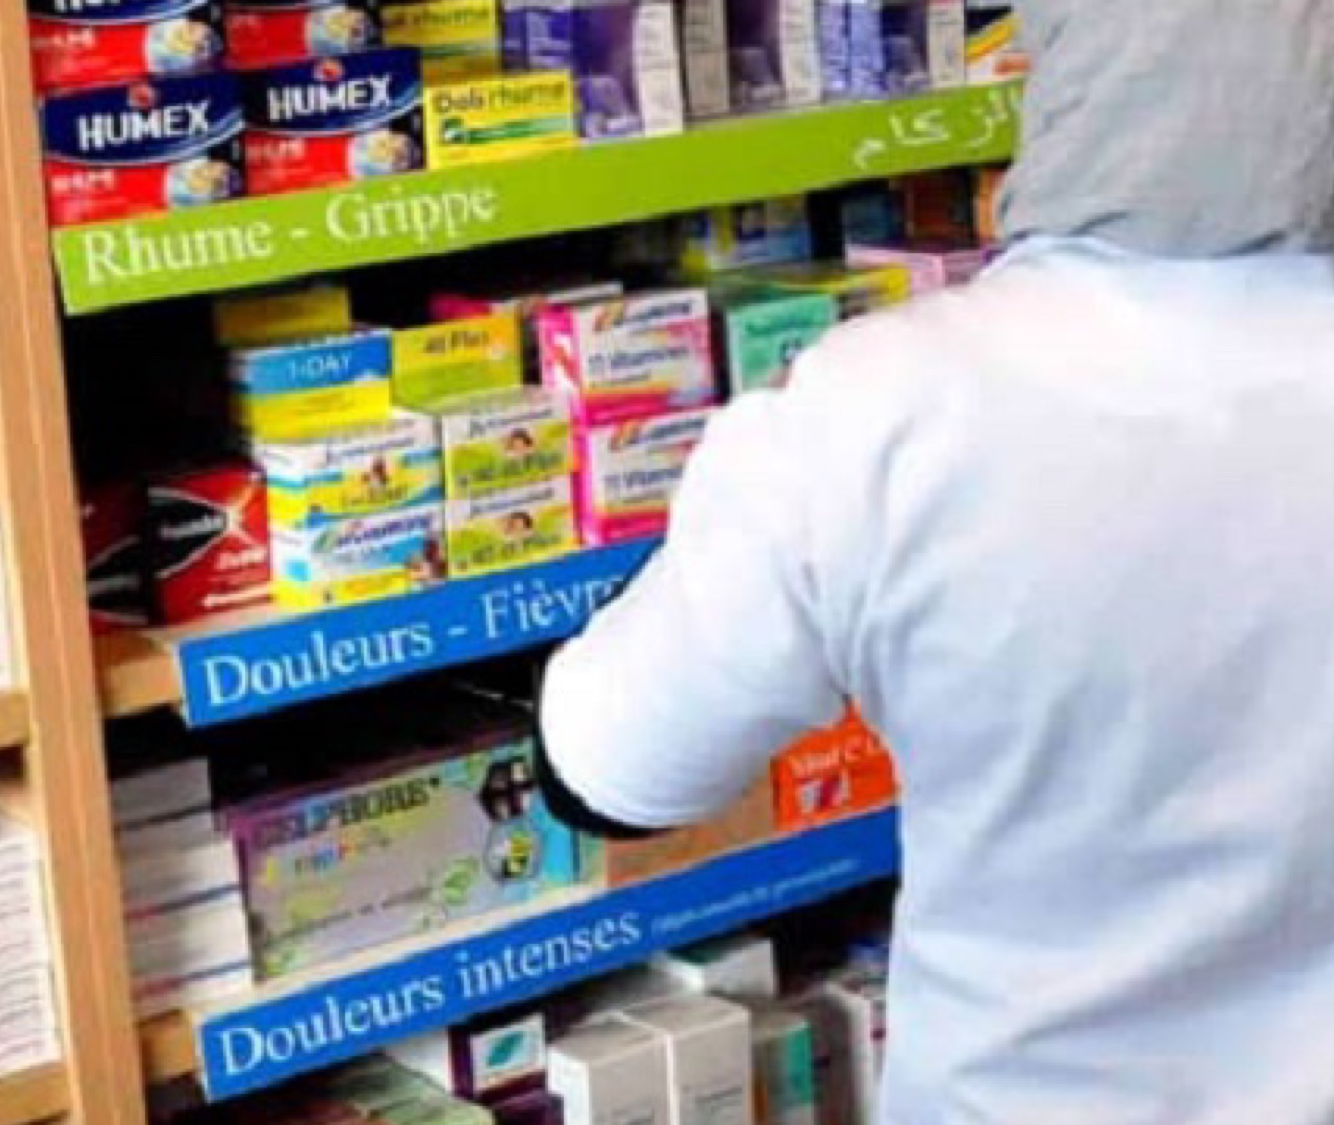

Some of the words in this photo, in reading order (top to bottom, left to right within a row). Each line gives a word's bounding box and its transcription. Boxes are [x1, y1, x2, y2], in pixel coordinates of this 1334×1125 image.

[77, 101, 211, 151] HUMEX
[268, 75, 393, 121] HUMEX
[82, 217, 275, 285] Rhume
[324, 185, 498, 248] Grippe
[203, 619, 435, 707] Douleurs
[482, 577, 624, 639] Fièvr
[219, 979, 446, 1077] Douleurs
[460, 908, 643, 1000] intenses
